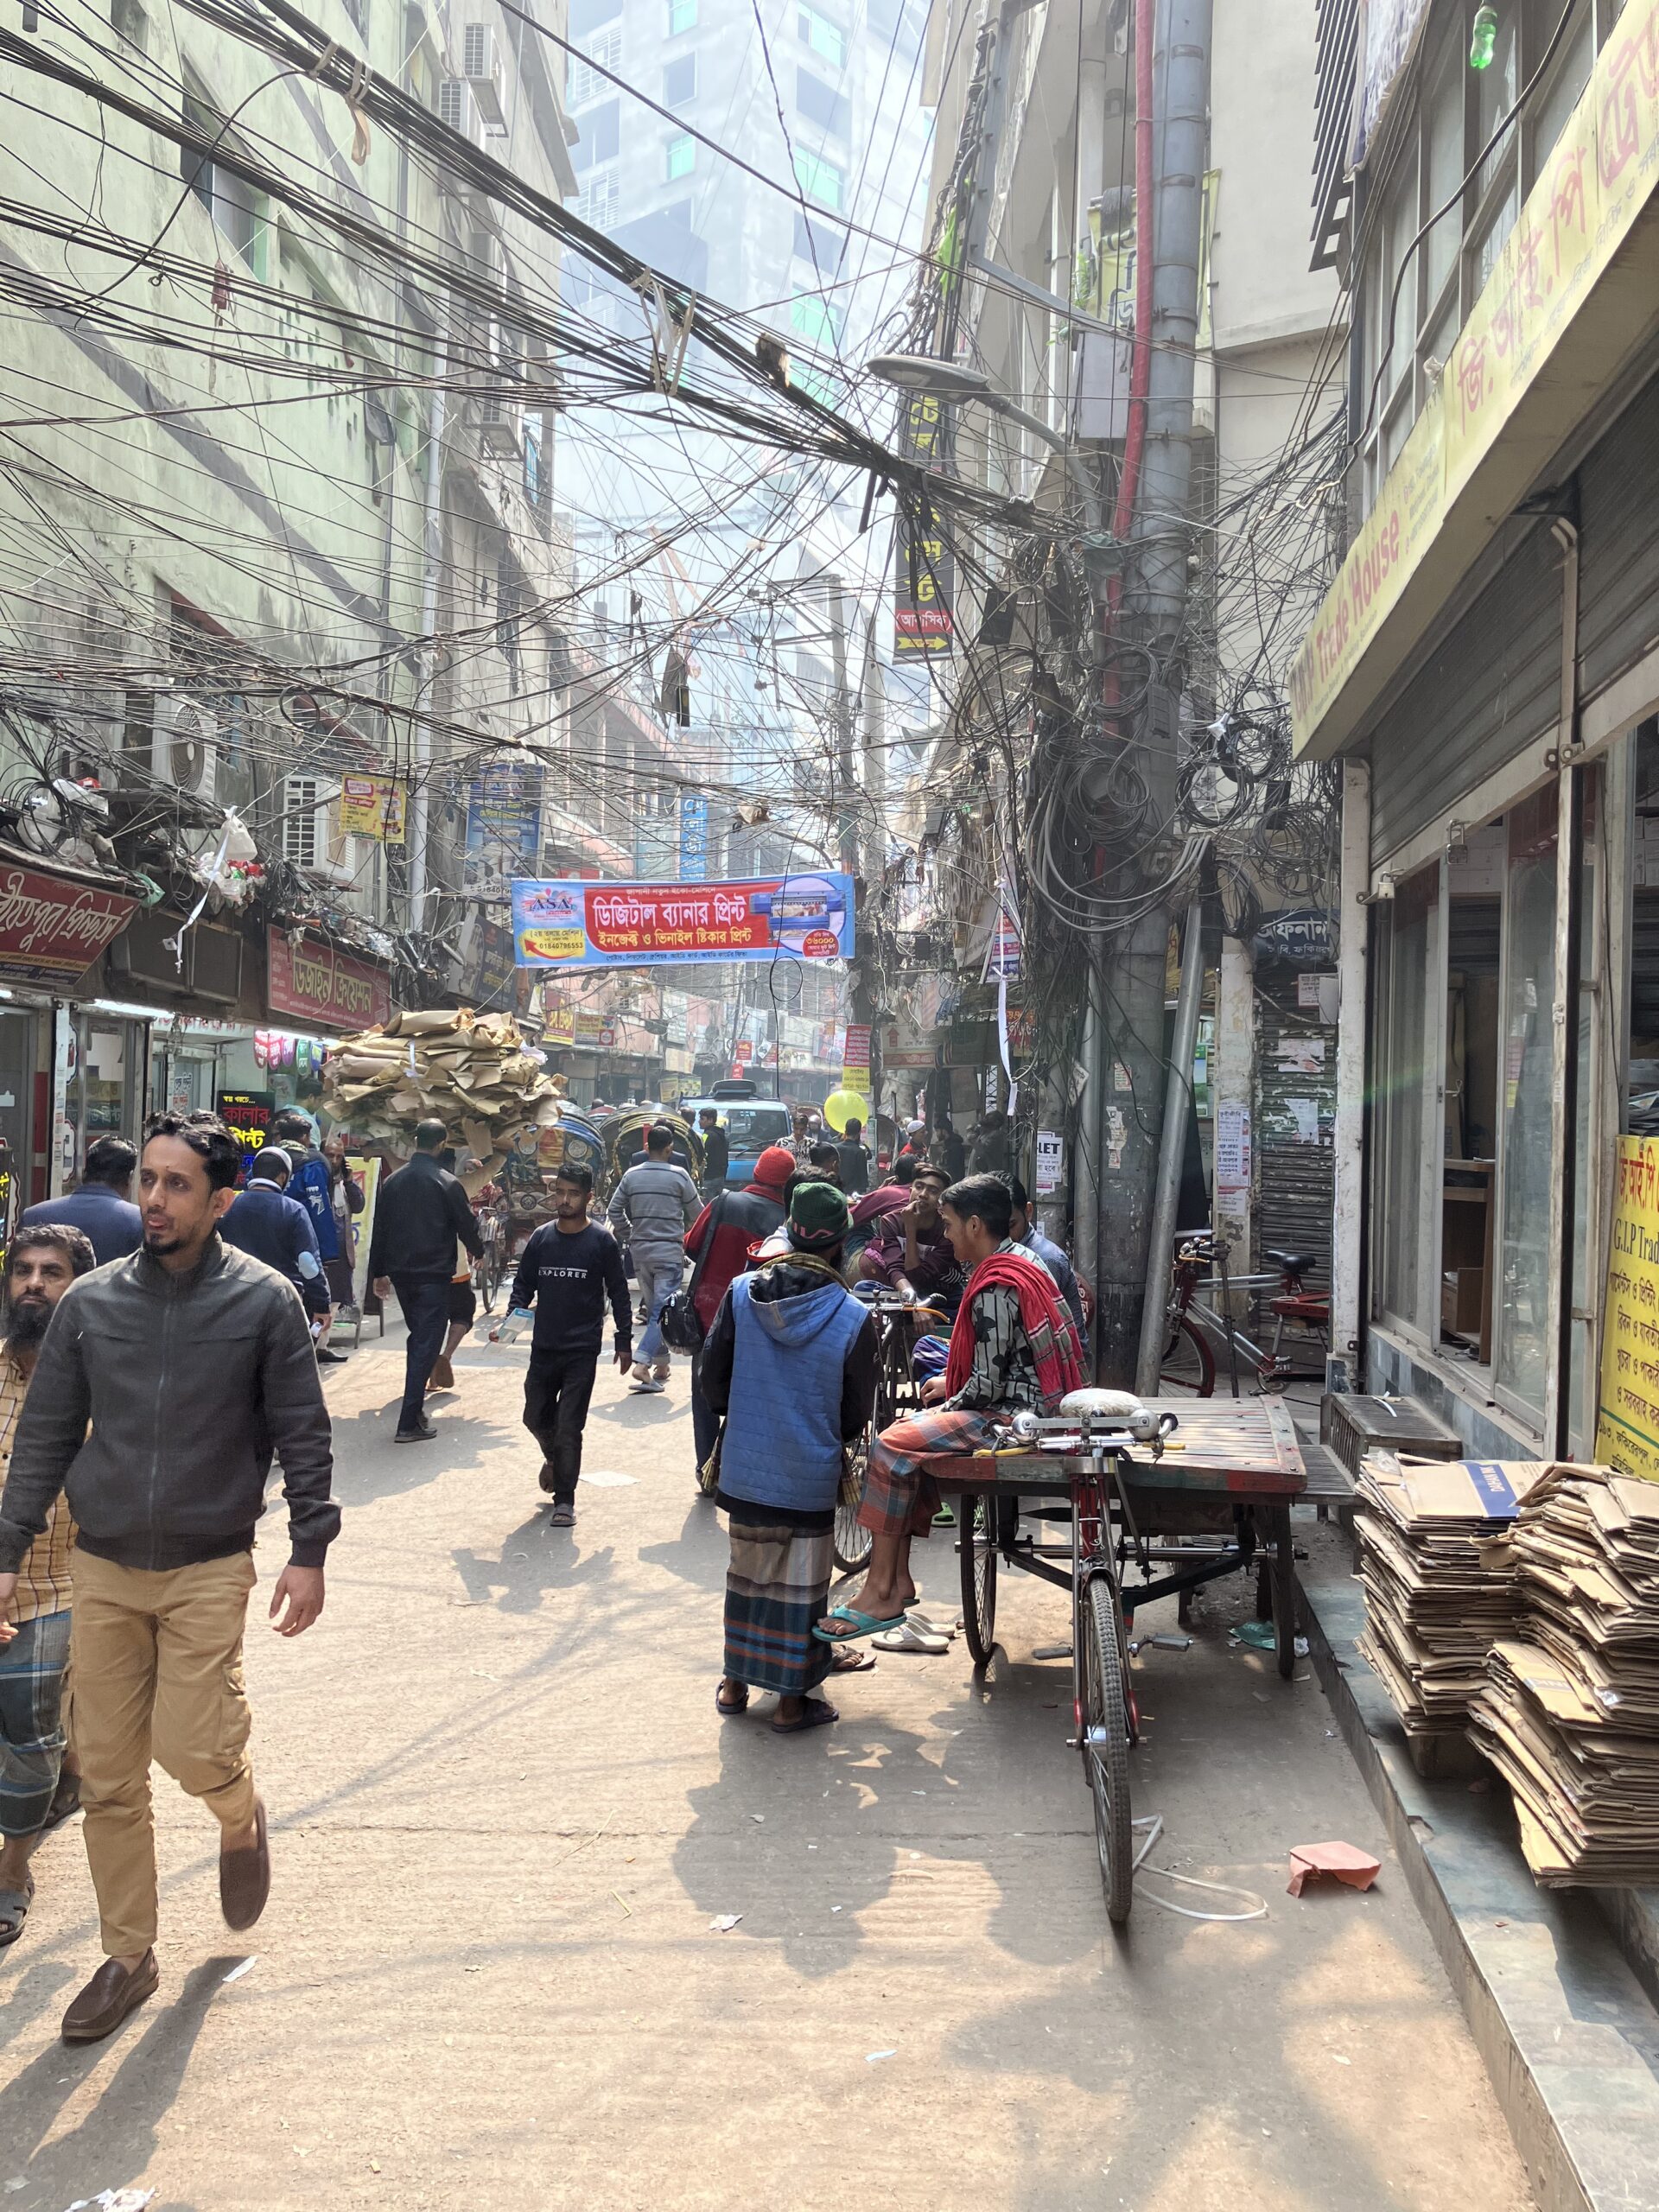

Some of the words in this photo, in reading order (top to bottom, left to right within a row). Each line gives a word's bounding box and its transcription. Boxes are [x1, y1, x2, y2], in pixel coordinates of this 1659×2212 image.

[1316, 595, 1350, 684] Trade
[1350, 510, 1400, 626] House
[531, 898, 571, 912] ASA
[592, 895, 658, 928] ডিজিটাল
[661, 900, 710, 927] ব্যানার
[713, 893, 747, 926] প্রিন্ট
[642, 933, 651, 945] ও
[654, 929, 693, 946] ভিনাইল
[729, 926, 752, 944] প্রিন্ট
[221, 1107, 270, 1125] কালার
[538, 1269, 587, 1279] EXPLORER
[1632, 1282, 1637, 1300] ও
[1633, 1320, 1638, 1338] ও
[1633, 1358, 1638, 1376] ও
[1617, 1386, 1622, 1403] ও
